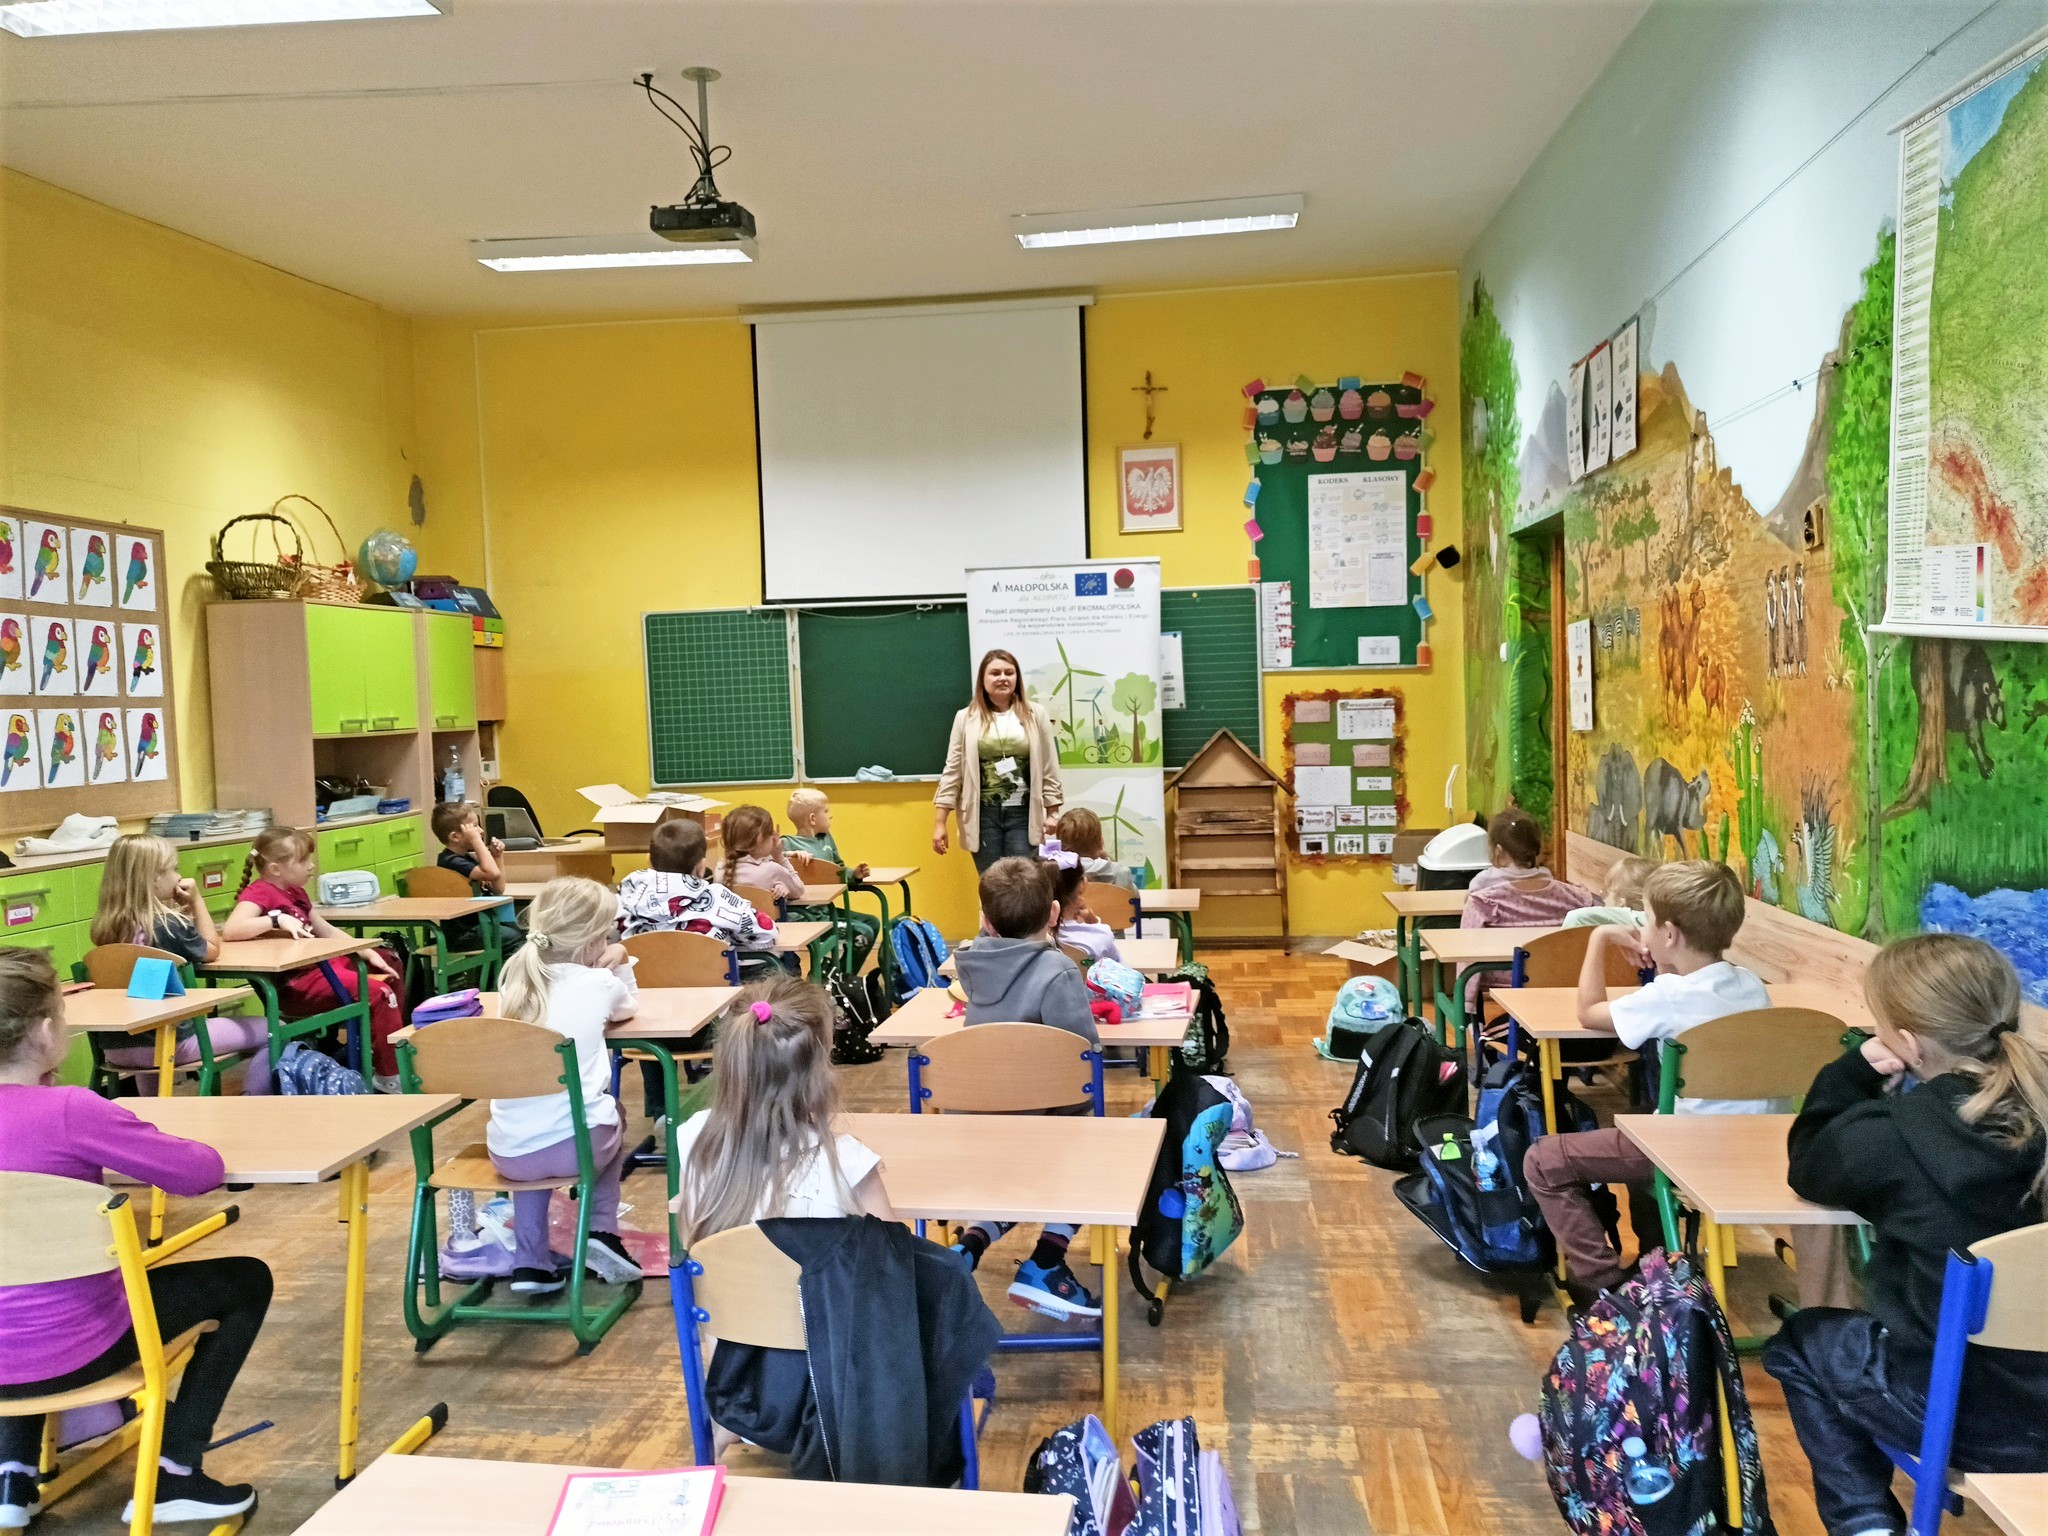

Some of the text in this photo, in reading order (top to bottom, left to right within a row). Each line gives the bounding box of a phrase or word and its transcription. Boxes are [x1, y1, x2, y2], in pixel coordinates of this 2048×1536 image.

[1317, 475, 1399, 485] KODEKS KLASOWY
[1005, 582, 1069, 592] MAŁOPOLSKA
[1009, 606, 1050, 615] zintegrowany
